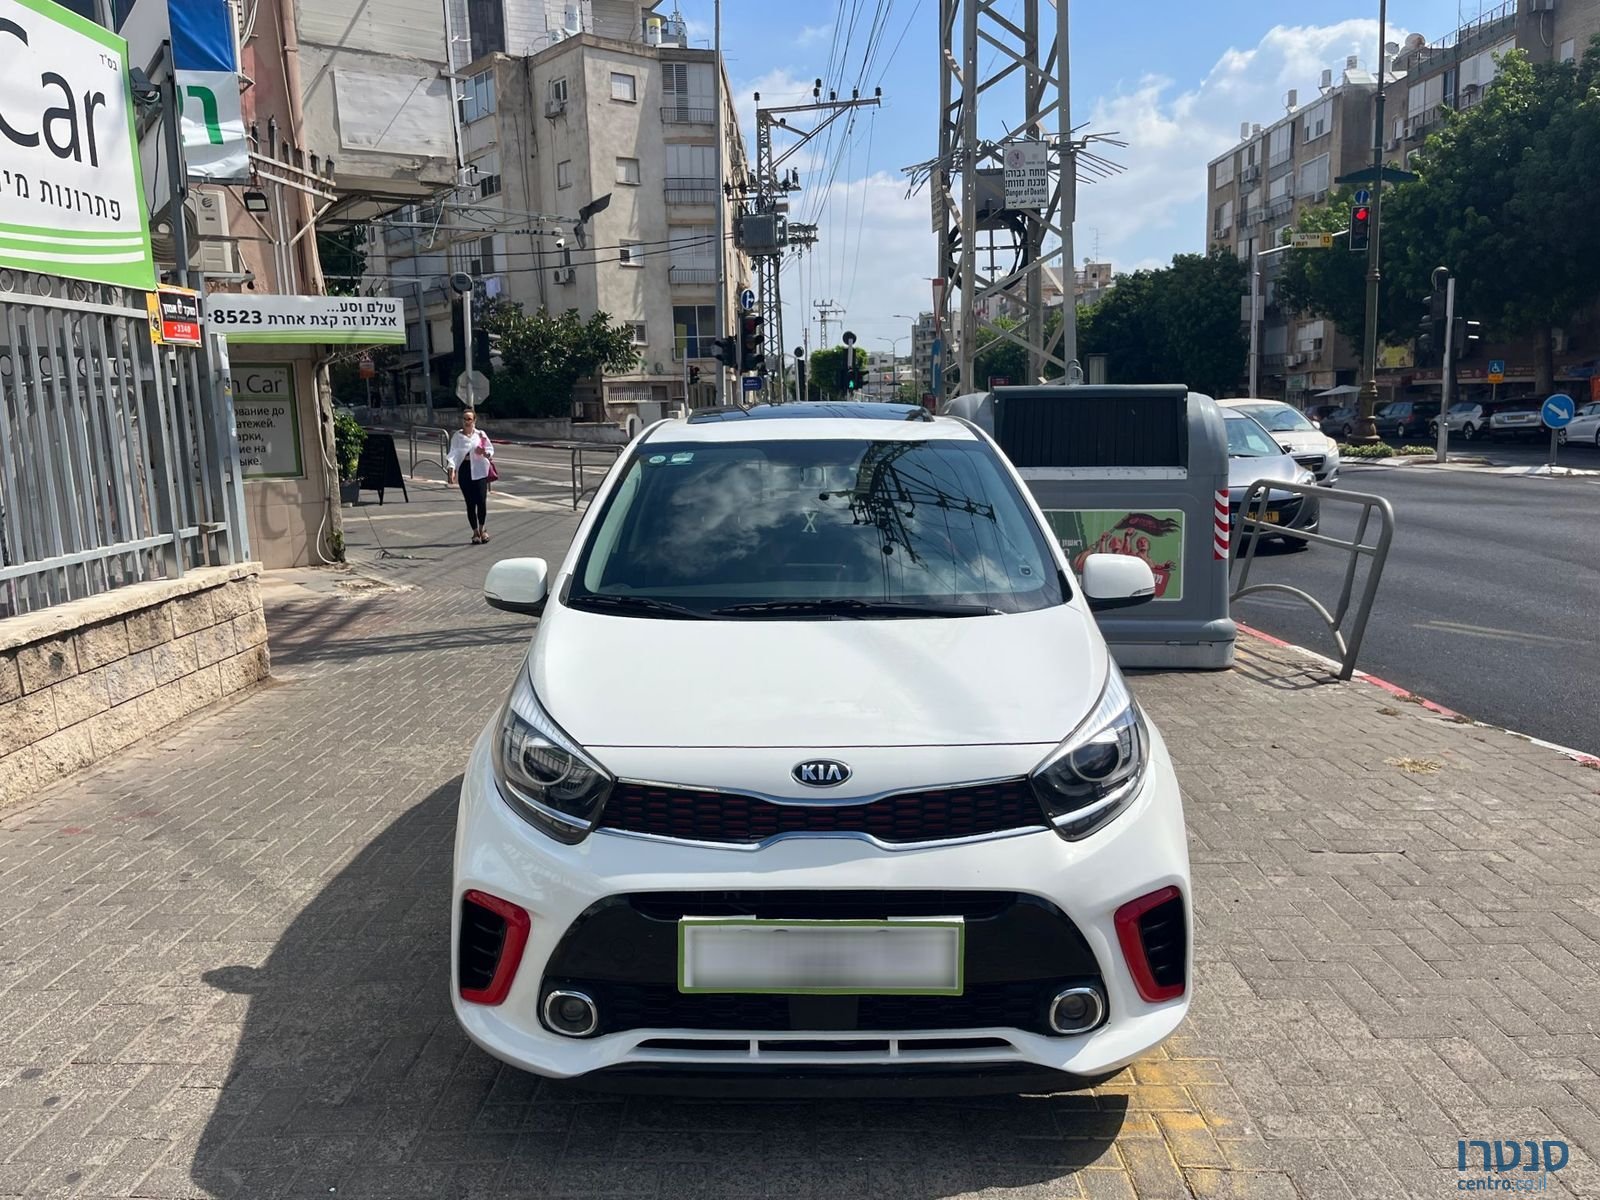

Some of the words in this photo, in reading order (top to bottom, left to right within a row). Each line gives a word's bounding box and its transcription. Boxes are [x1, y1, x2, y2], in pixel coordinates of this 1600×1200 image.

[0, 17, 106, 169] Car
[1005, 169, 1026, 178] גבוה!
[1029, 168, 1045, 177] מתח
[0, 170, 30, 198] מי
[1005, 179, 1025, 188] מוות!
[1027, 178, 1046, 187] סכנת
[1006, 189, 1023, 197] Danger
[1024, 188, 1029, 196] of
[40, 180, 121, 221] פתרונות
[326, 302, 363, 314] וסע...
[367, 301, 396, 314] שלם
[267, 314, 306, 326] אחרת
[310, 314, 339, 329] קצת
[343, 315, 357, 326] זה
[361, 314, 397, 327] אצלנו
[246, 374, 282, 394] Car
[271, 407, 285, 417] до
[236, 418, 276, 429] атежей.
[254, 445, 266, 453] на
[239, 457, 262, 467] ыке.
[801, 764, 842, 781] KIA
